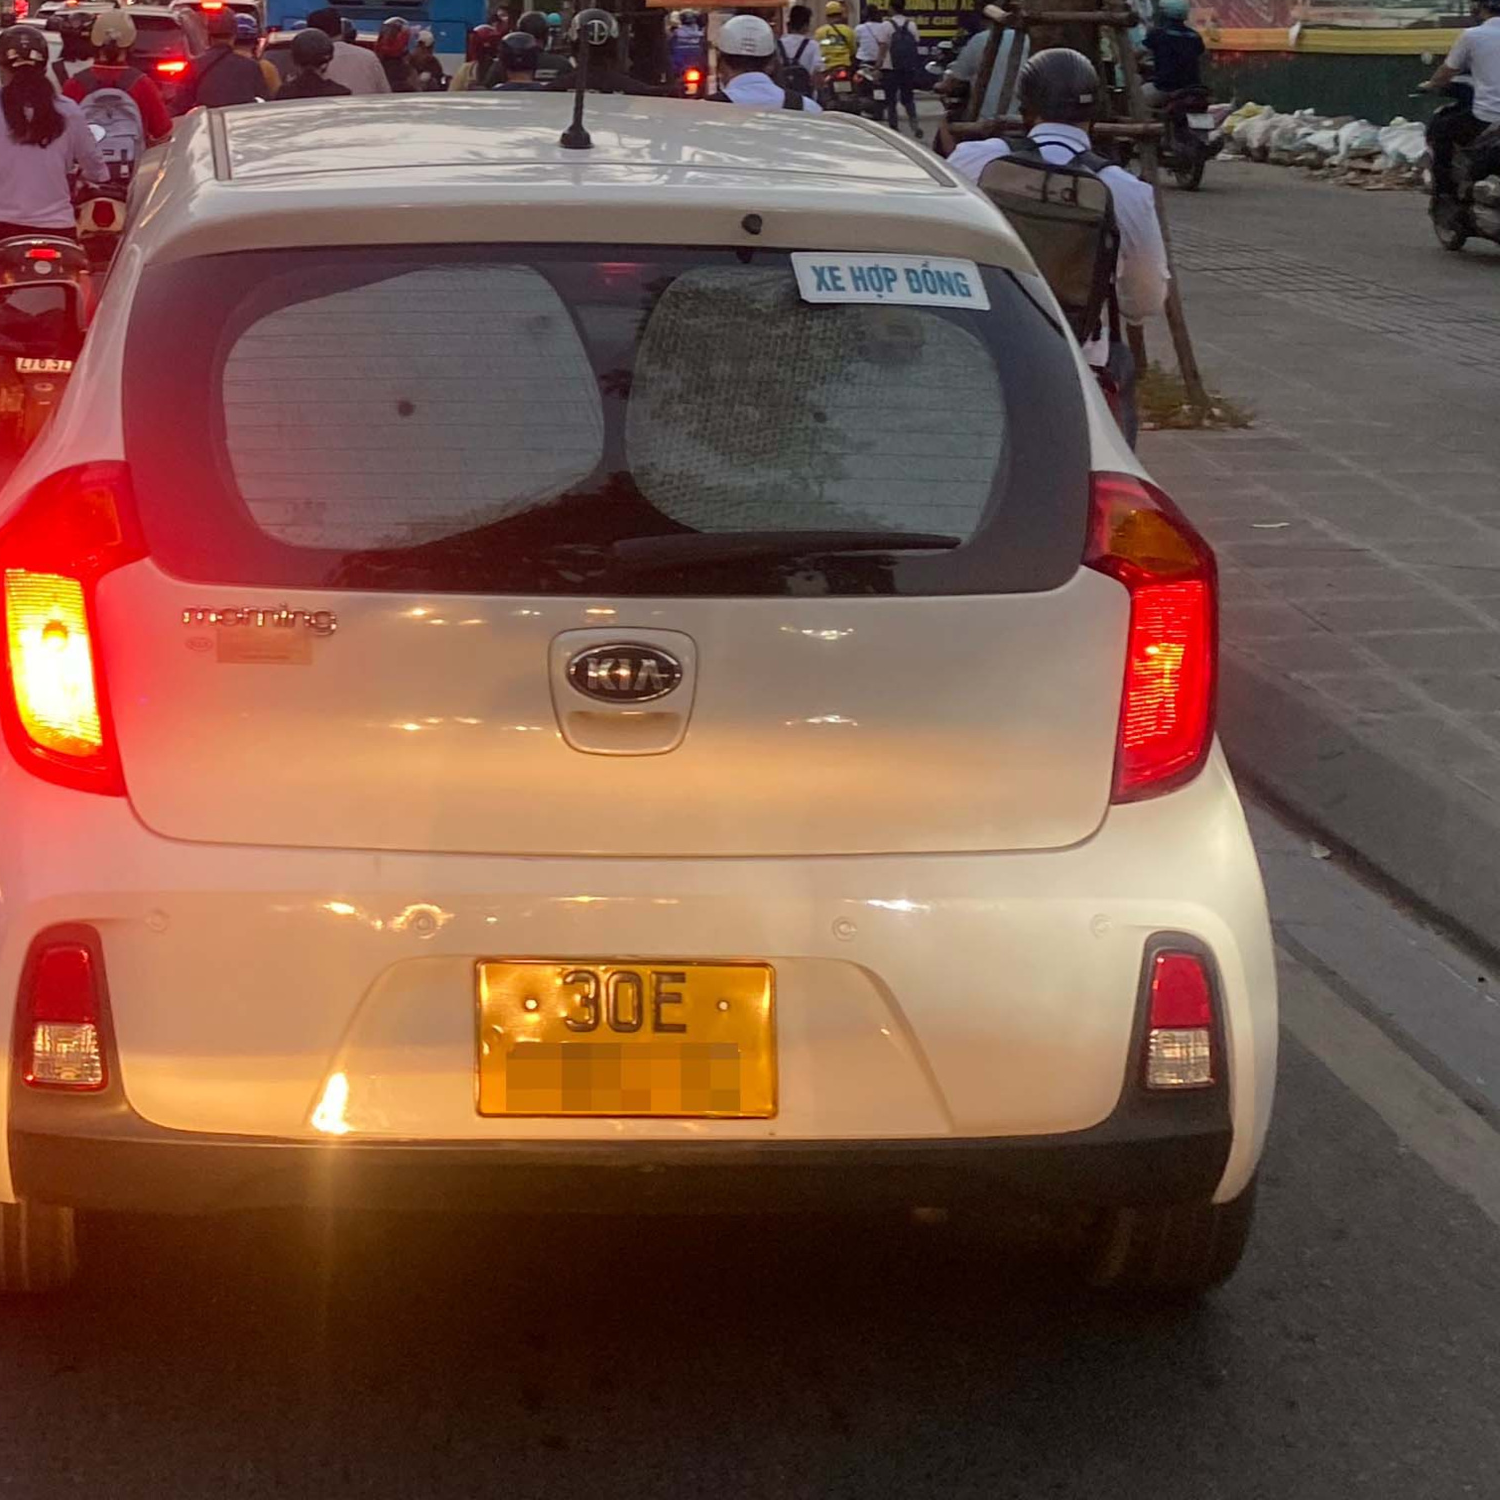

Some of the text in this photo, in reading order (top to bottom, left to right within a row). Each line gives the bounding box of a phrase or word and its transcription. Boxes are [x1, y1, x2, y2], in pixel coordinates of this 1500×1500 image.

[810, 265, 845, 292] XE
[849, 264, 897, 298] HỢP
[182, 603, 337, 637] morning
[586, 658, 664, 691] KIA
[563, 970, 687, 1033] 30E
